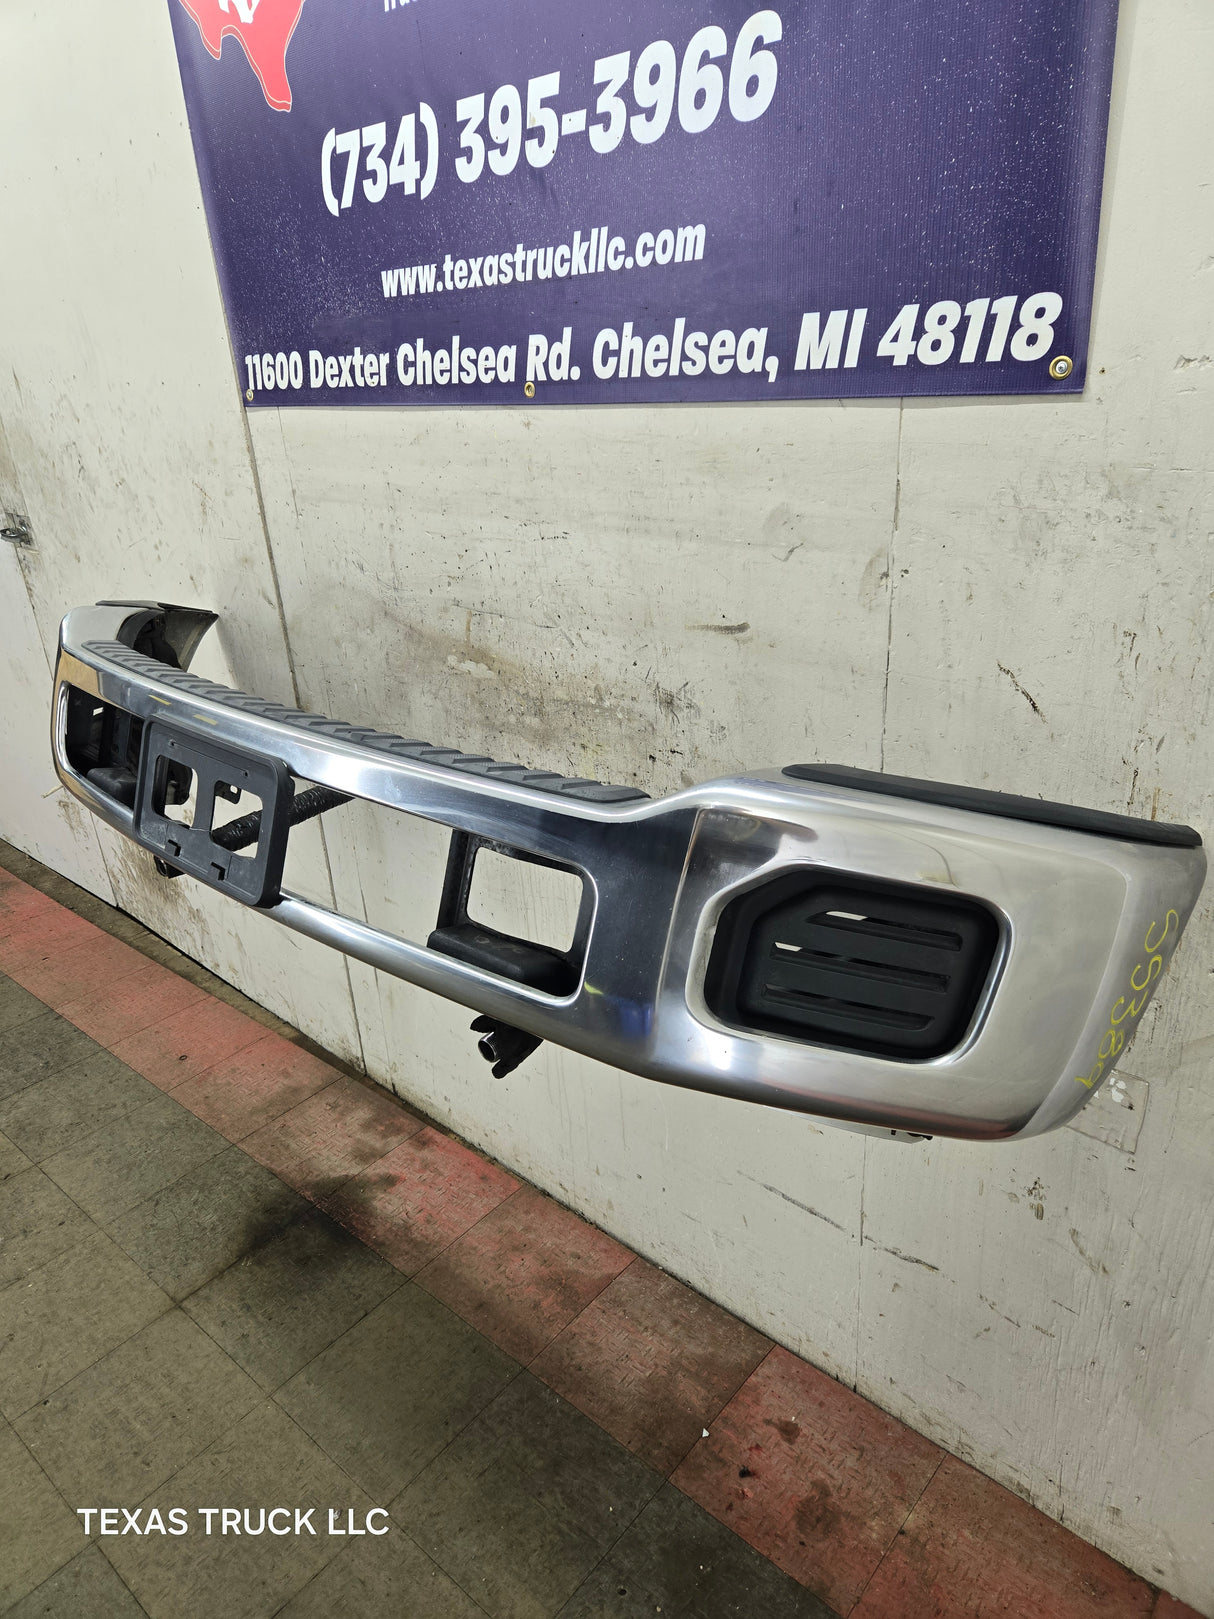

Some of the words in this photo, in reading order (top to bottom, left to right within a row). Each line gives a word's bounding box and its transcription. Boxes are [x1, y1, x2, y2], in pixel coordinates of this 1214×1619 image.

[321, 101, 439, 217] (734)
[454, 9, 783, 184] 395-3966
[380, 223, 706, 298] www.texastruckllc.com
[244, 350, 304, 391] 11600
[308, 347, 390, 389] Dexter
[396, 334, 517, 386] Chelsea
[525, 326, 582, 382] Rd.
[592, 317, 780, 383] Chelsea,
[794, 307, 869, 371] MI
[876, 291, 1064, 367] 48118
